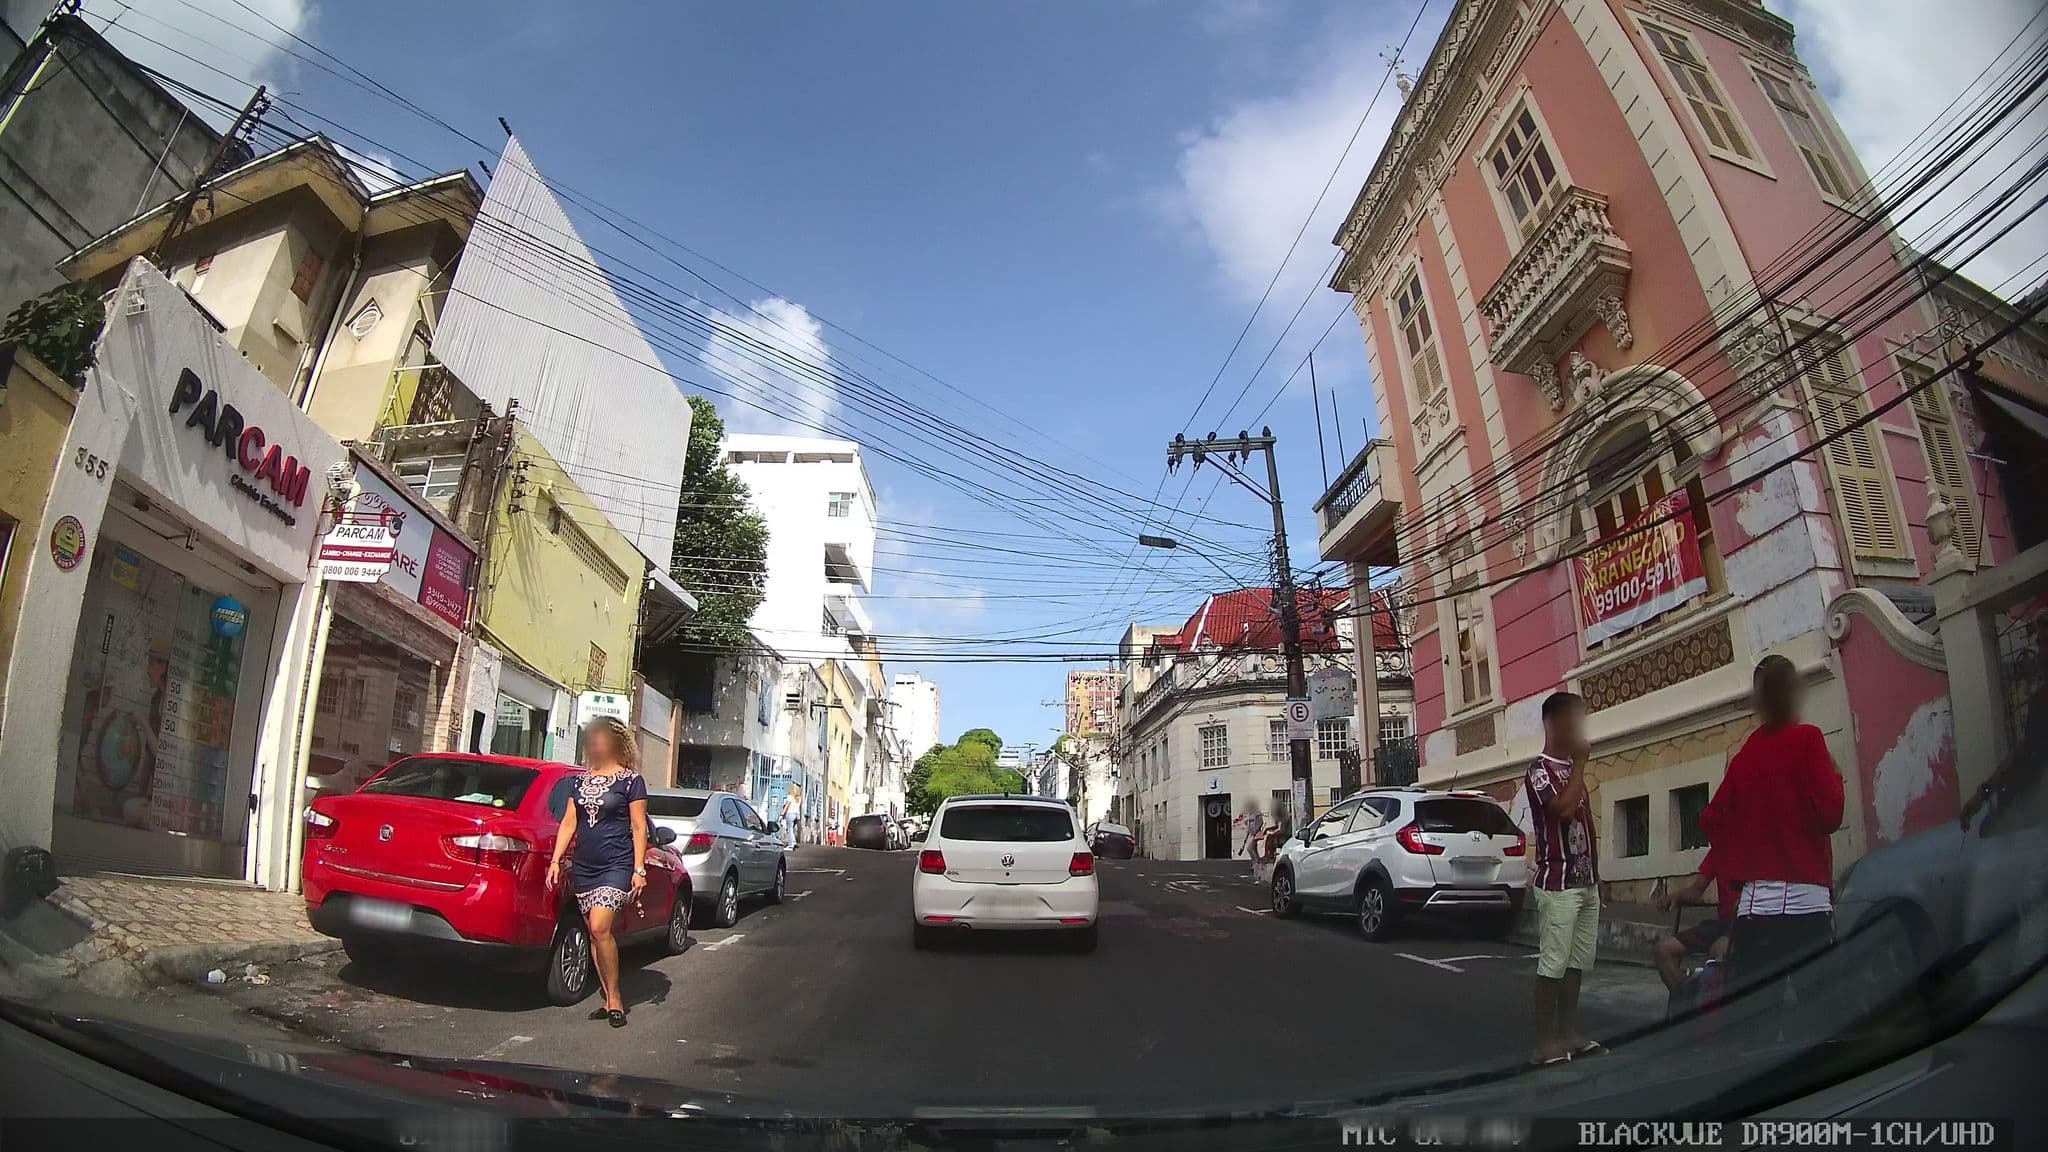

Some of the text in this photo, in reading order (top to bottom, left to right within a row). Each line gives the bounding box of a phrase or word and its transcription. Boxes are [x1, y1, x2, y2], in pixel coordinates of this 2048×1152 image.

[169, 367, 311, 507] PARCAM
[75, 446, 109, 479] 355
[336, 527, 386, 541] PARCAM
[393, 549, 419, 579] ARÉ
[323, 566, 343, 575] 0800
[344, 567, 360, 577] 006
[169, 681, 181, 694] 50
[166, 700, 178, 713] 50
[1295, 705, 1304, 718] E
[164, 718, 176, 732] 50
